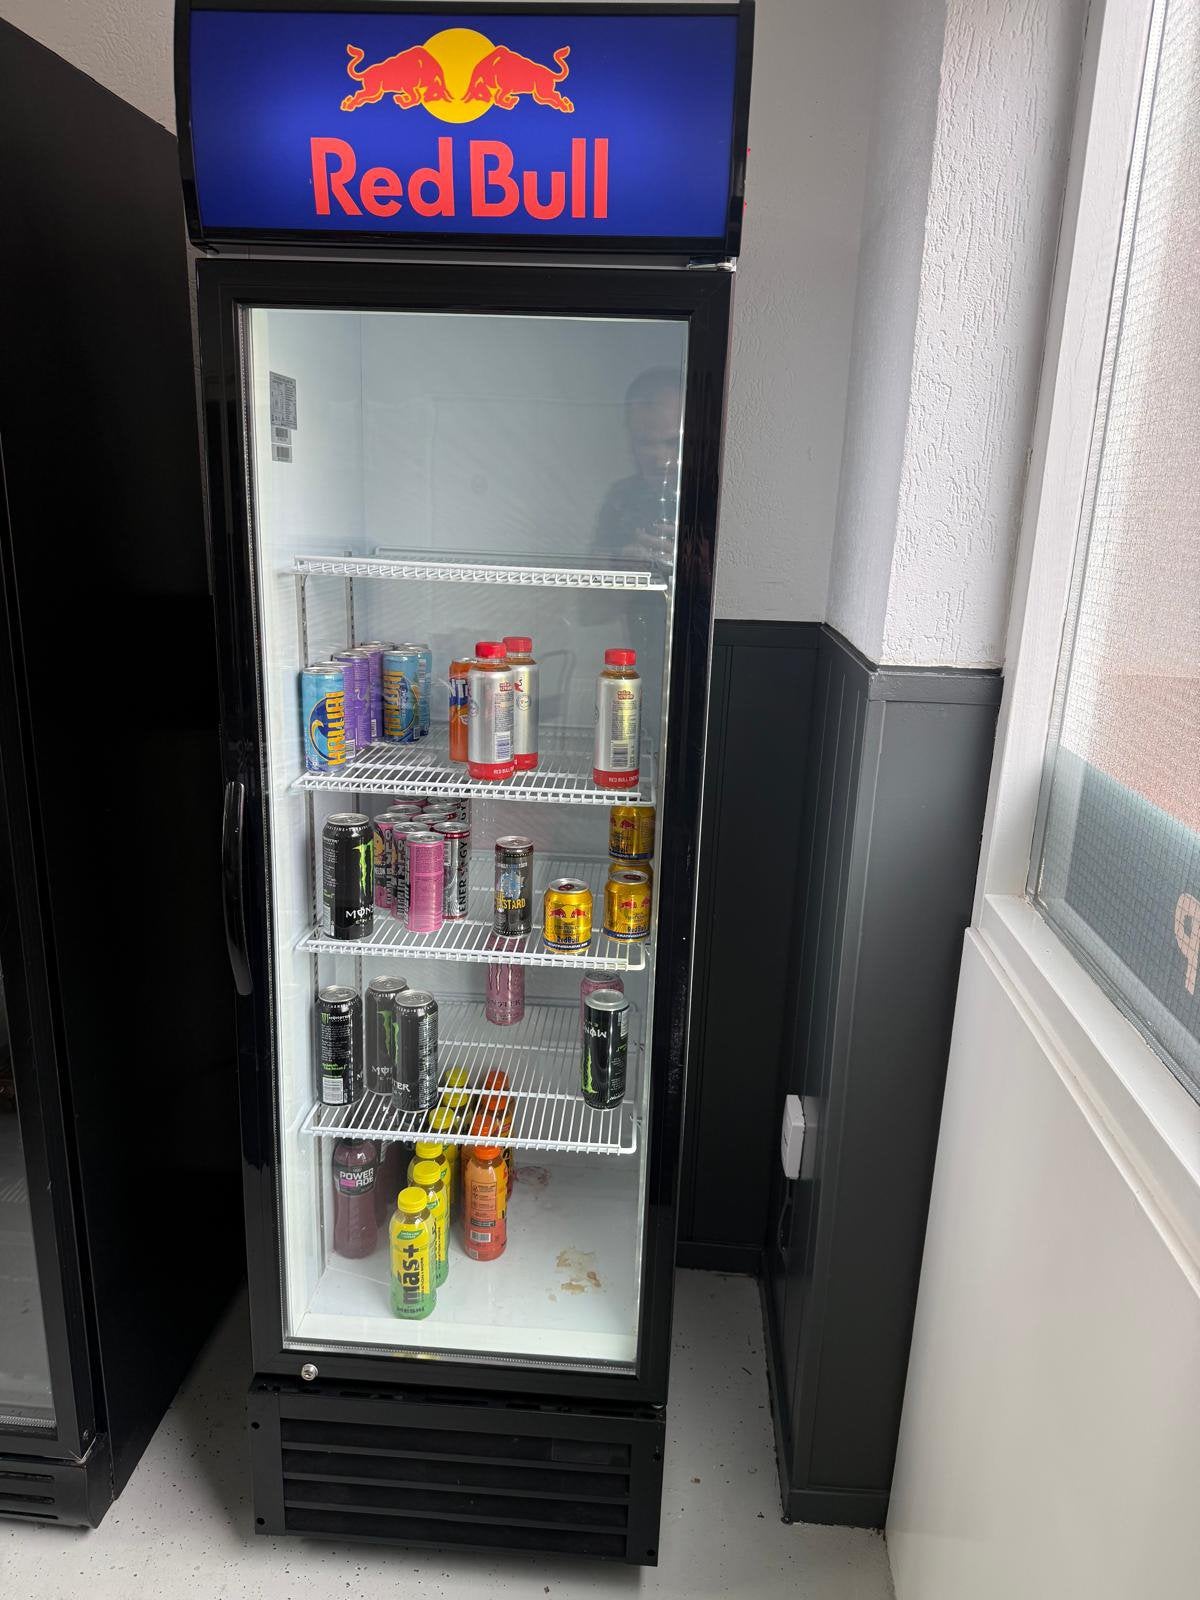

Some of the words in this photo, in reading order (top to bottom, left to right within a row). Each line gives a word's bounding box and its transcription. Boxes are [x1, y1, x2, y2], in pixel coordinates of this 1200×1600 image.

[310, 136, 456, 218] Red
[469, 137, 609, 220] Bull
[339, 1167, 374, 1180] POWER
